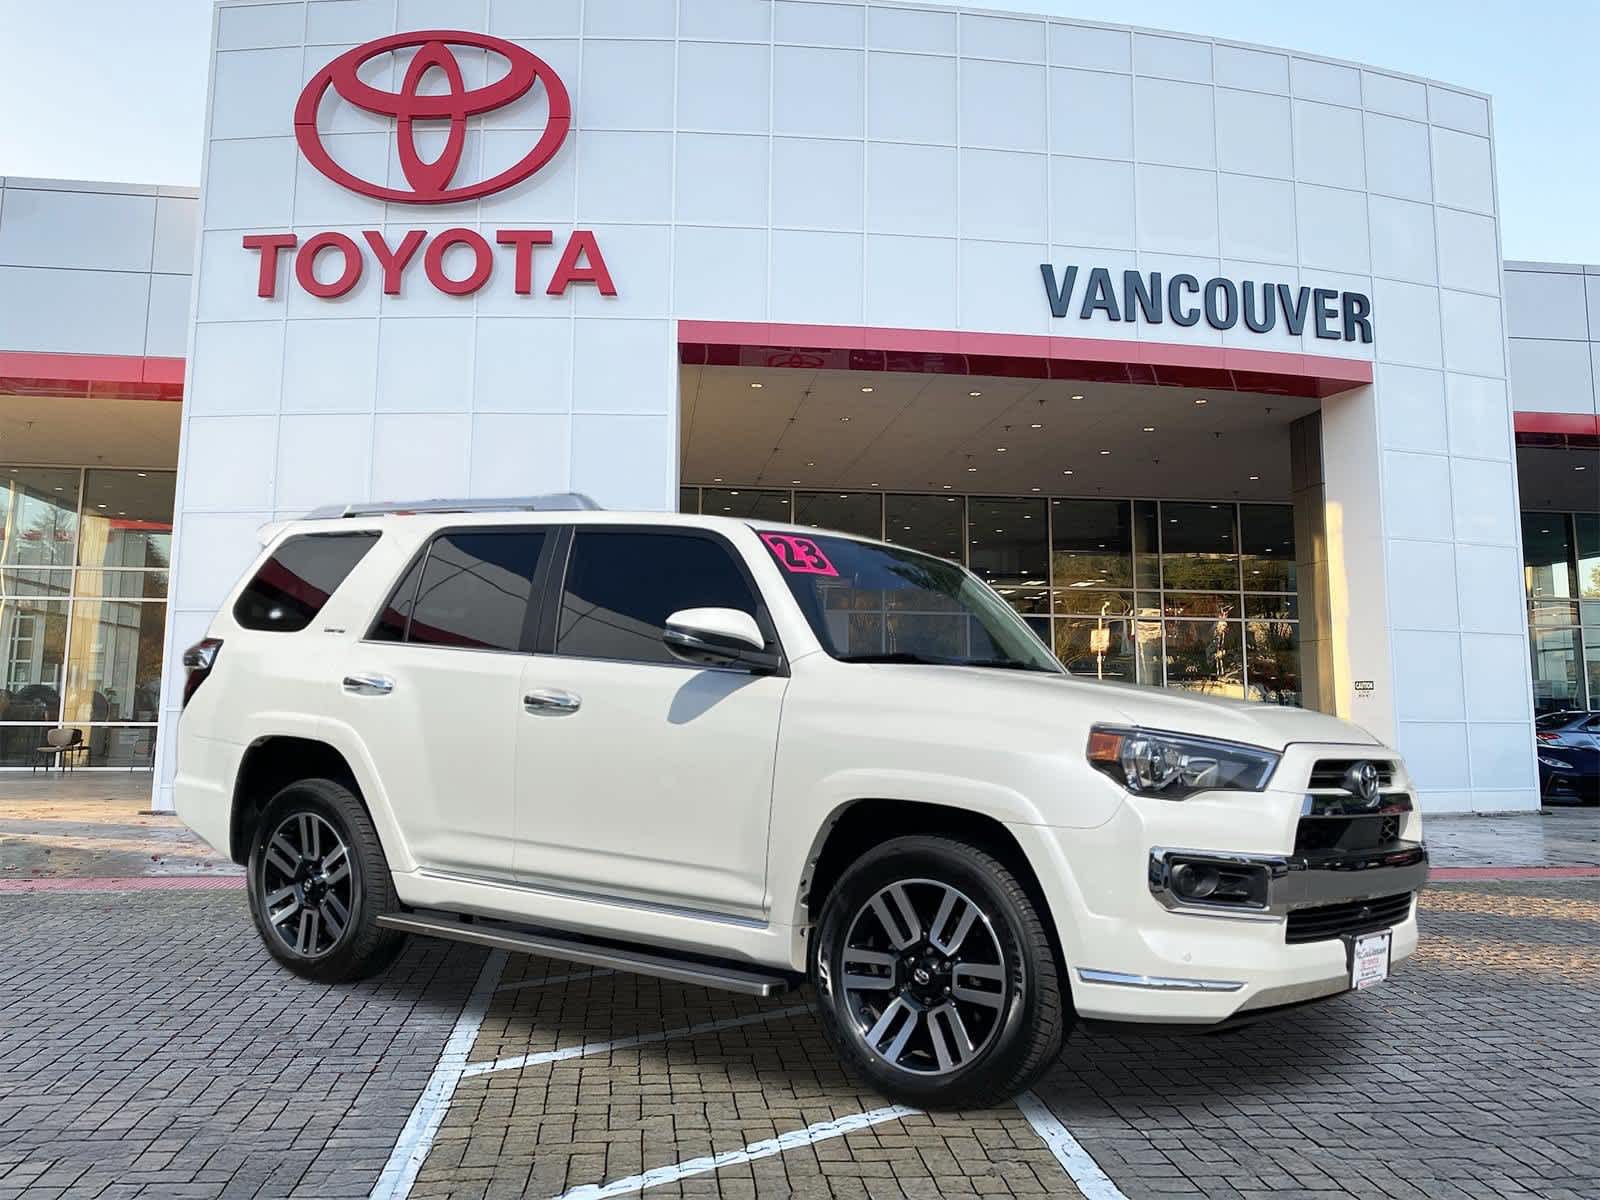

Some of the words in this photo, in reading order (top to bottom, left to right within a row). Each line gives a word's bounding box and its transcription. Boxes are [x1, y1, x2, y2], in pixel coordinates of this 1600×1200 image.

[242, 227, 618, 299] TOYOTA
[1040, 264, 1373, 344] VANCOUVER
[768, 536, 827, 570] 23
